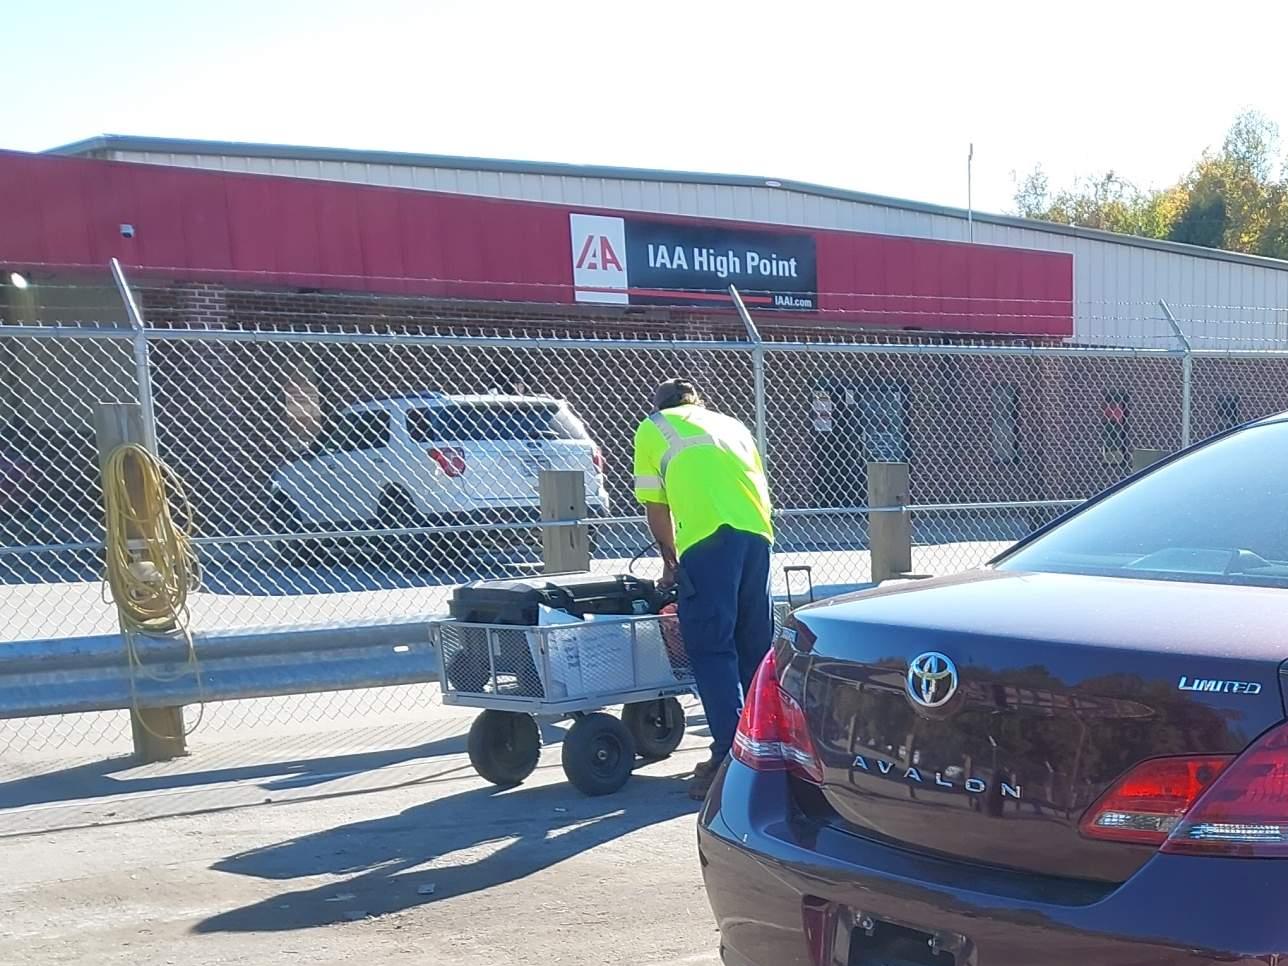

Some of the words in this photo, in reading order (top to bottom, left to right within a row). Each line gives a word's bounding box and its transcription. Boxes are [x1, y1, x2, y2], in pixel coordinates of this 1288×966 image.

[647, 244, 688, 270] IAA
[693, 247, 741, 278] High
[746, 252, 798, 278] Point
[1178, 675, 1263, 695] LIMITED
[851, 754, 1023, 799] AVALON
